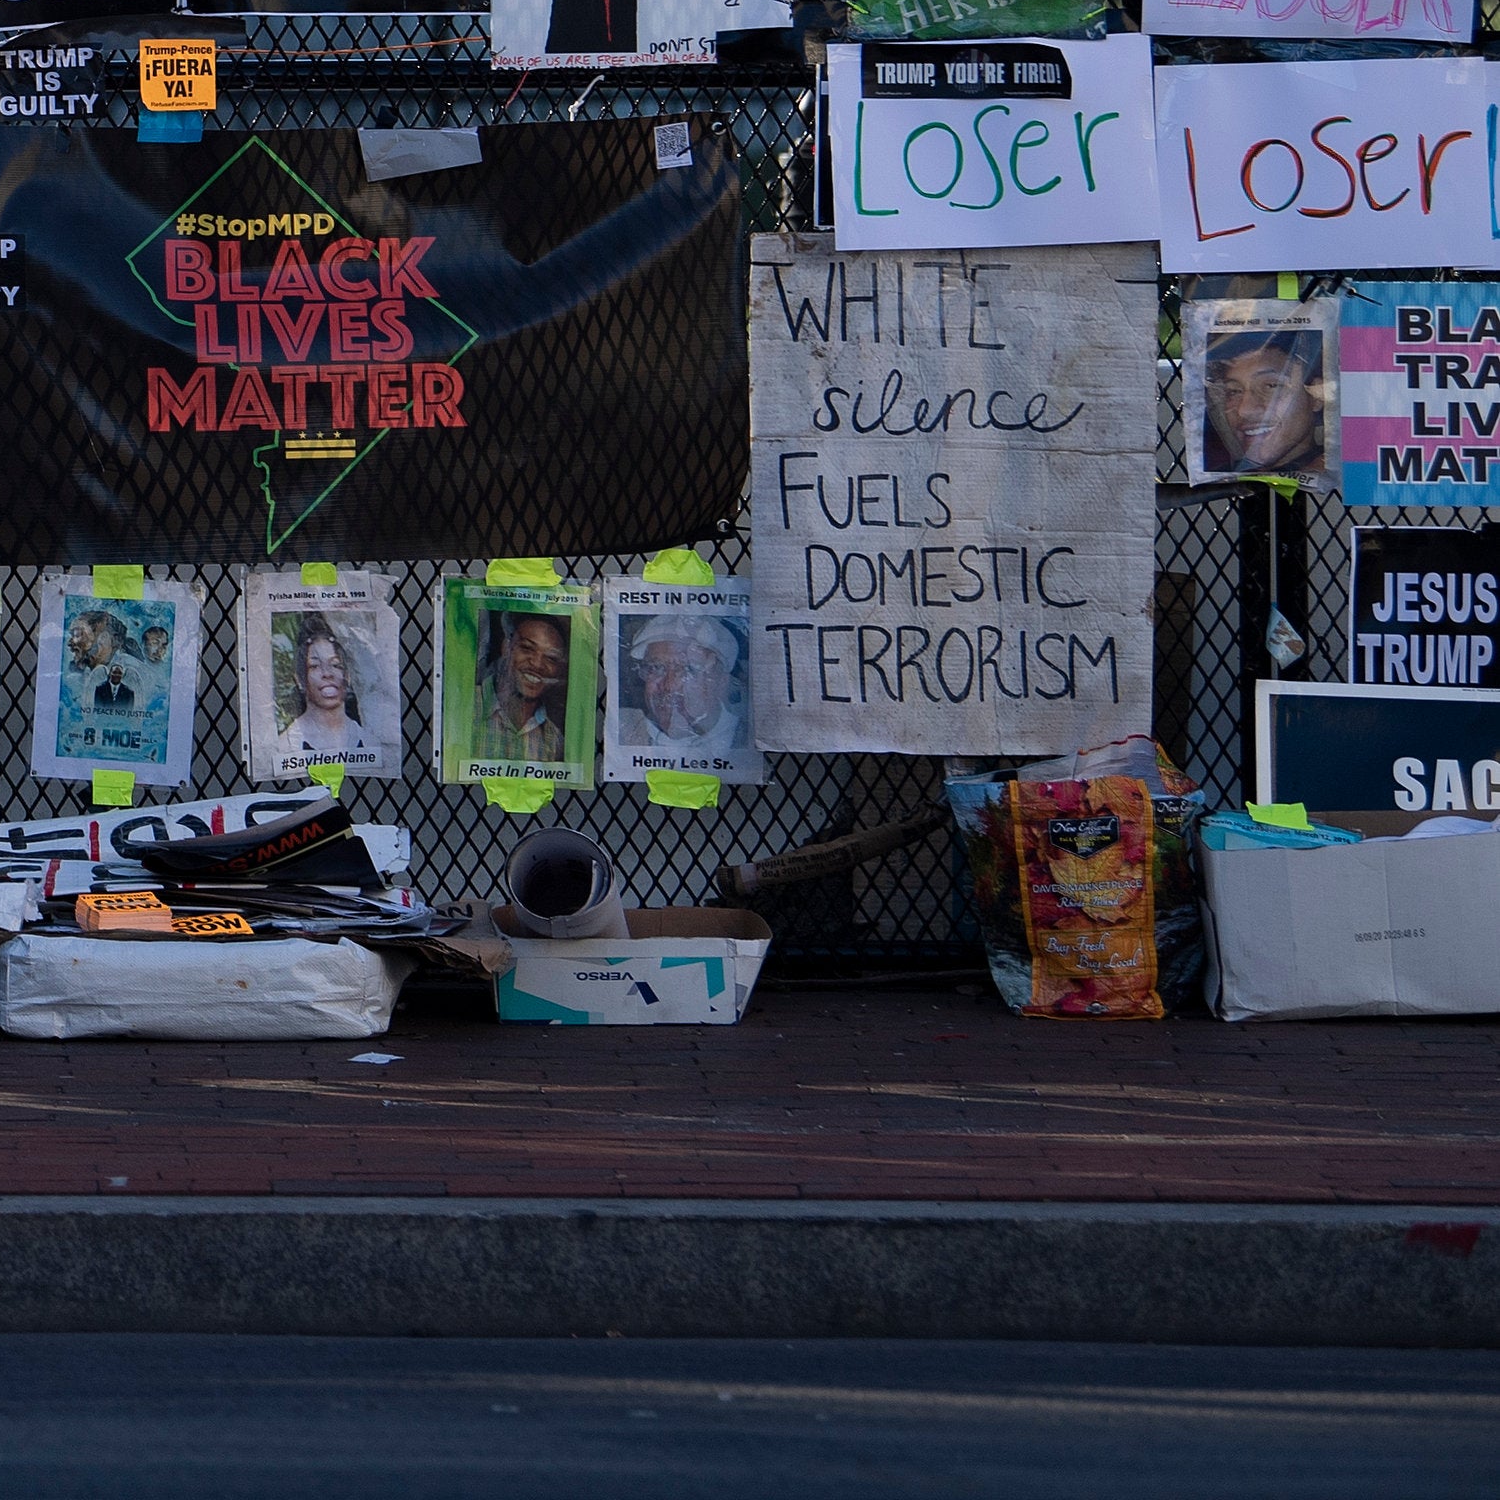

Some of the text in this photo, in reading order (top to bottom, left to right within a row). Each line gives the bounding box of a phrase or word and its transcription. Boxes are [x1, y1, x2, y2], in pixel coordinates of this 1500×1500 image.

[0, 47, 94, 69] TRUMP
[145, 45, 213, 55] Trump-Pence
[146, 59, 213, 80] ¡FUERA
[875, 63, 1062, 87] TRUMP, YOU'RE FIRED!
[0, 94, 99, 116] GUILTY
[36, 72, 61, 92] IS
[164, 81, 193, 98] YA!
[176, 212, 334, 239] #StopMPD
[164, 236, 440, 301] BLACK
[770, 262, 1011, 350] WHITE
[195, 301, 414, 364] LIVES
[147, 362, 469, 431] MATTER
[812, 370, 1084, 433] silence
[779, 452, 951, 529] FUELS
[804, 544, 1087, 611] DOMESTIC
[1372, 572, 1498, 623] JESUS
[767, 623, 1119, 704] TERRORISM
[1358, 633, 1493, 684] TRUMP
[281, 751, 376, 772] #SayHerName
